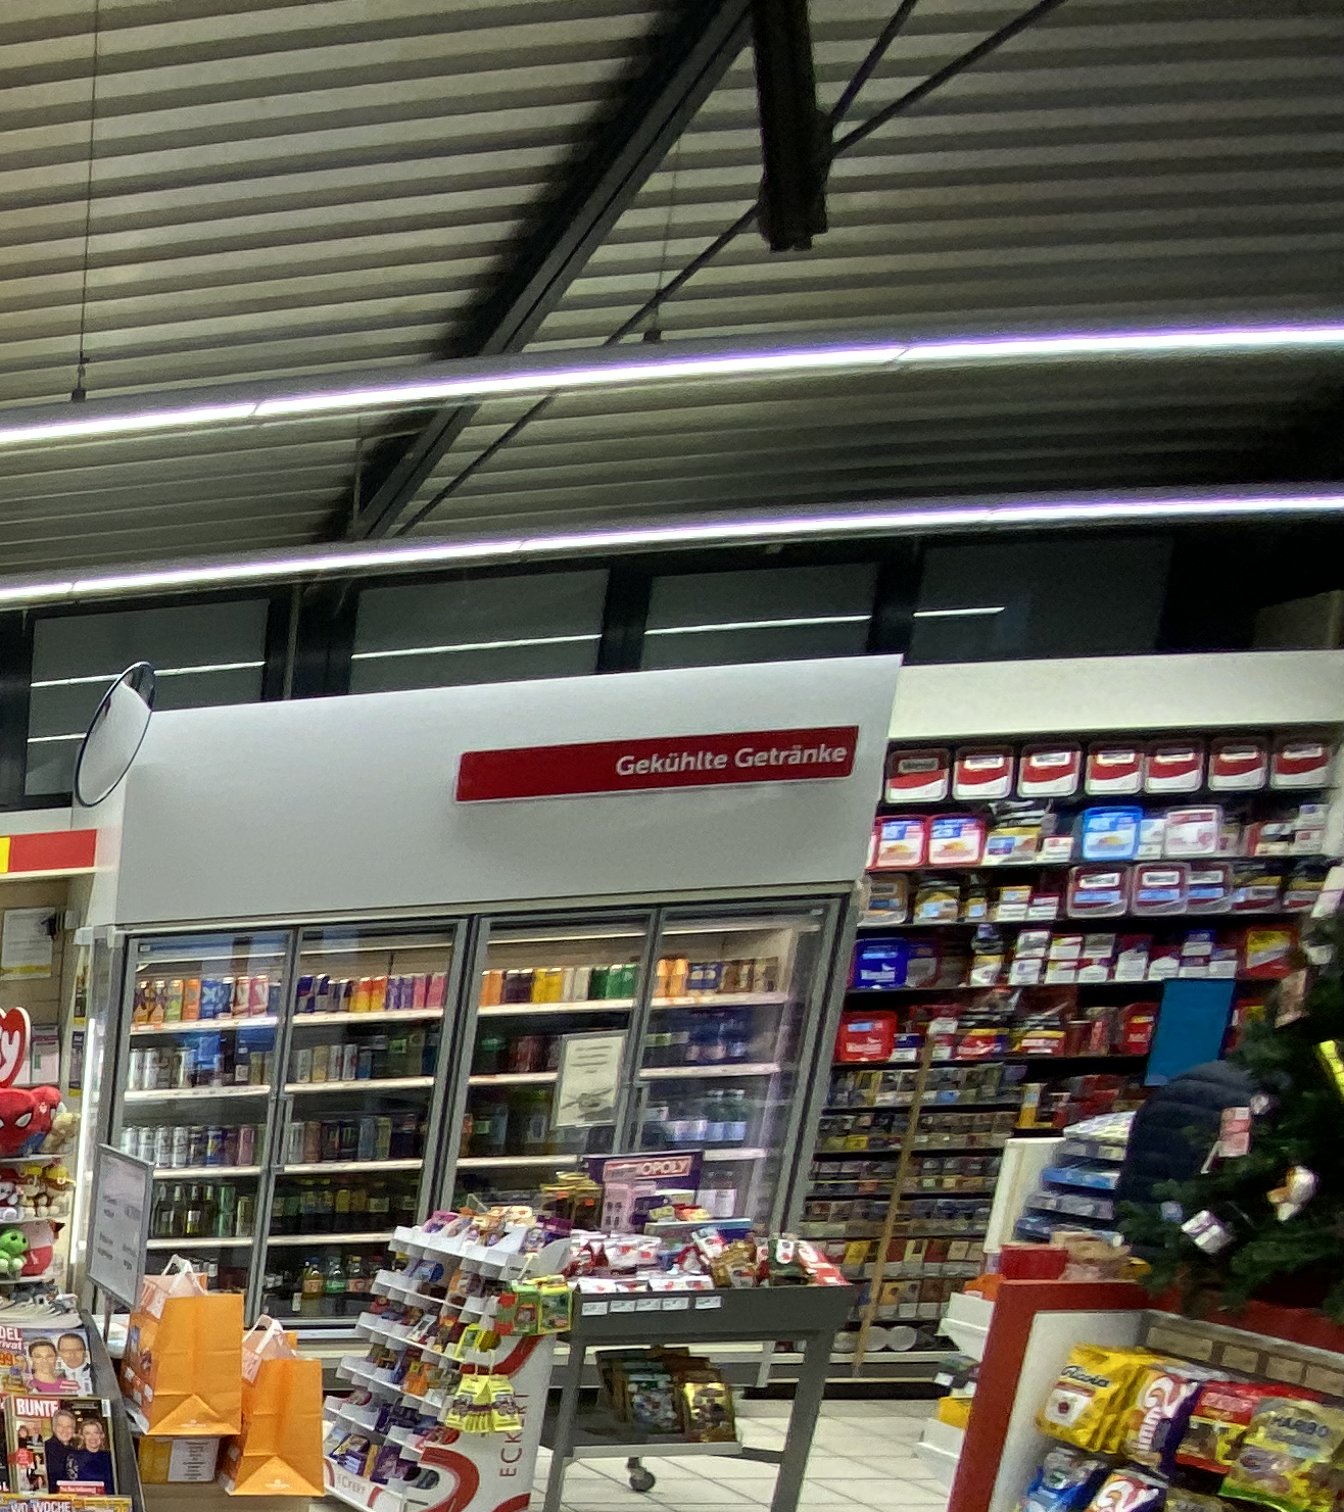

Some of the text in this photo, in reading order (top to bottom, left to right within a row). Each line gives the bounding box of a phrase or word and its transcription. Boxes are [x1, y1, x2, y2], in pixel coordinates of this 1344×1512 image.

[616, 742, 848, 776] Gekühlte Getränke
[15, 1398, 58, 1418] BUNTE
